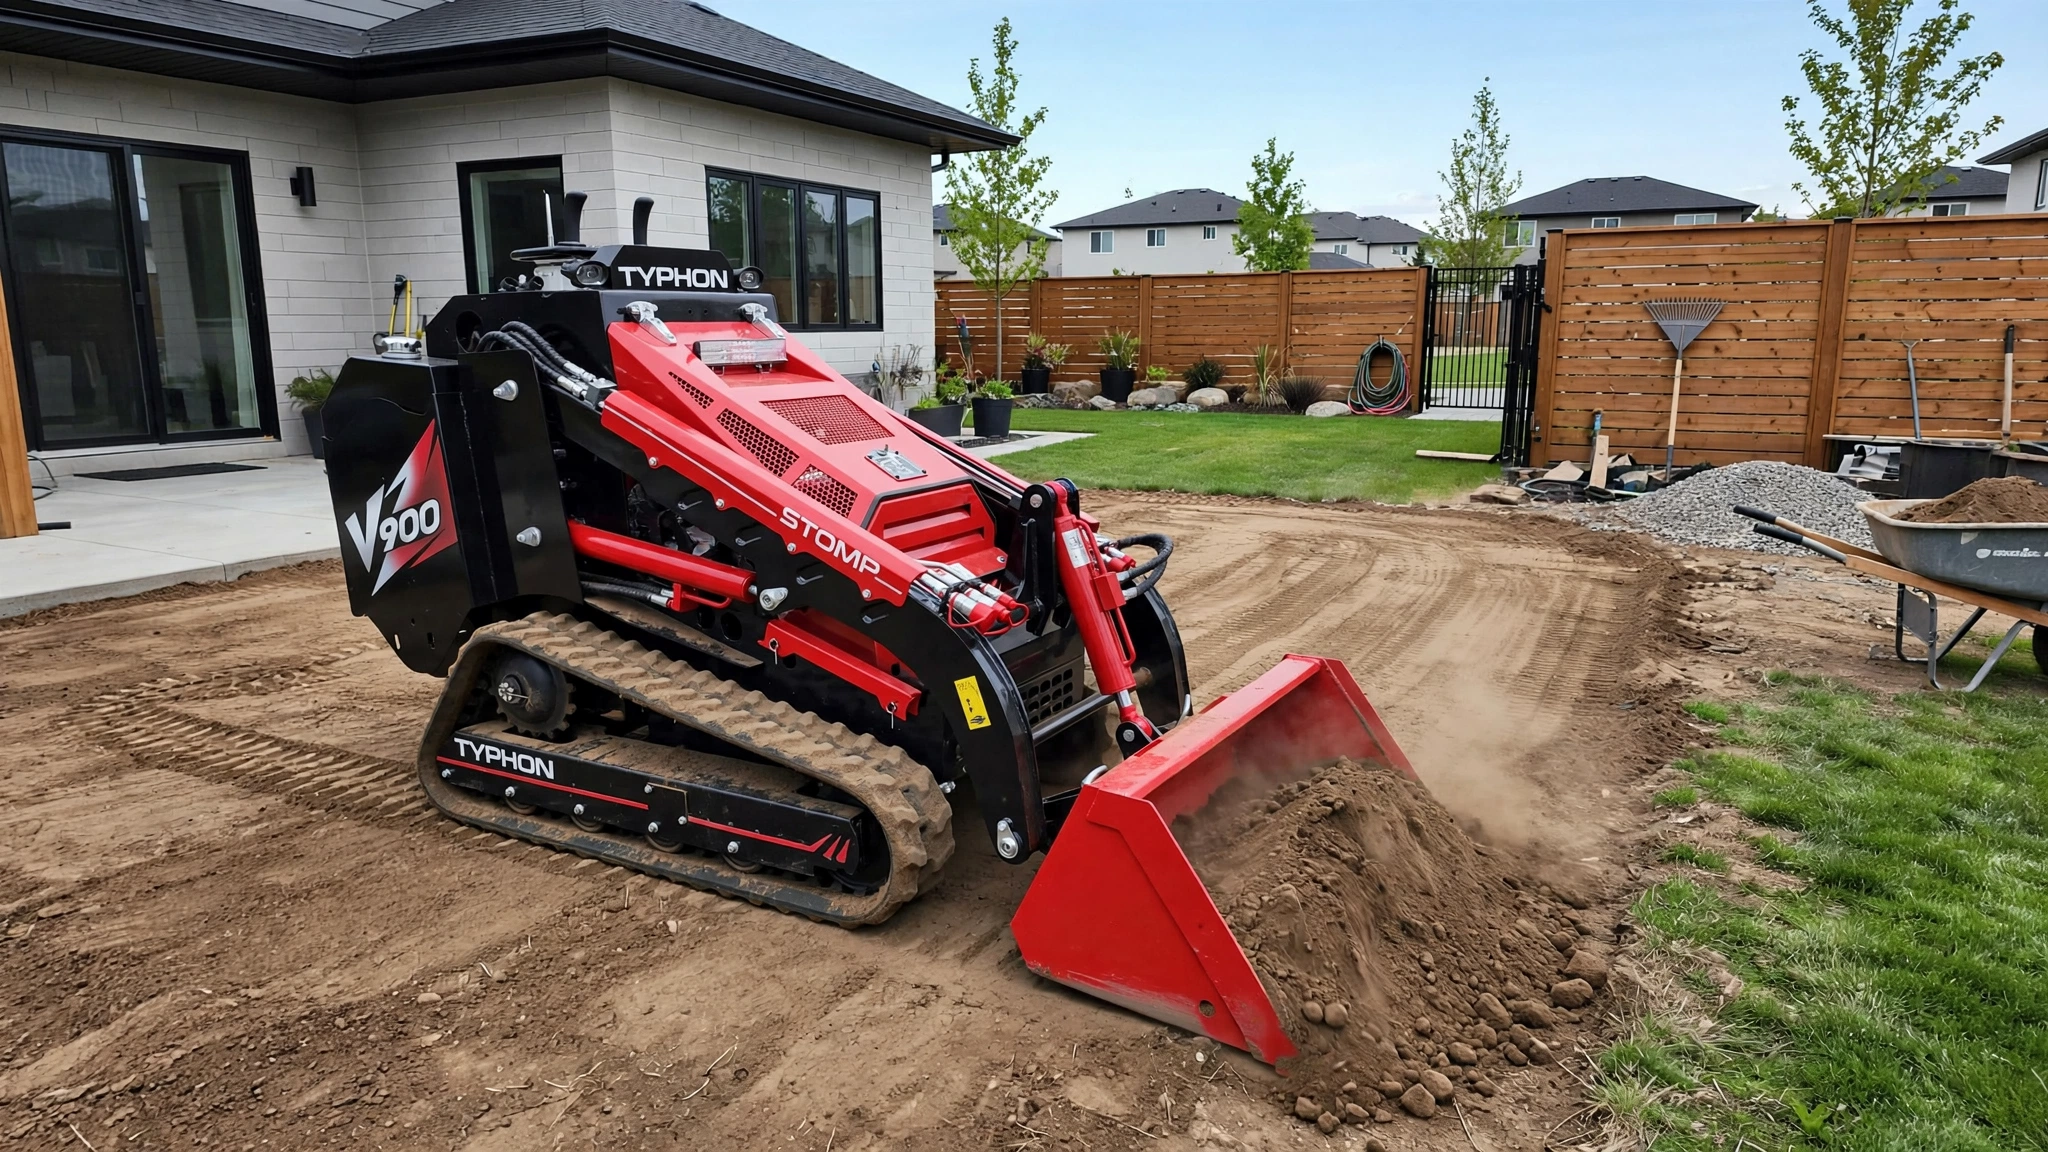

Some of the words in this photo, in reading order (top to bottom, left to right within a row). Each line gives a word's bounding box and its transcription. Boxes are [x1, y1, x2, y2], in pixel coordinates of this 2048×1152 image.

[617, 266, 729, 289] TYPHON
[345, 484, 441, 574] V900
[780, 506, 880, 575] STOMP
[453, 737, 555, 780] TYPHON
